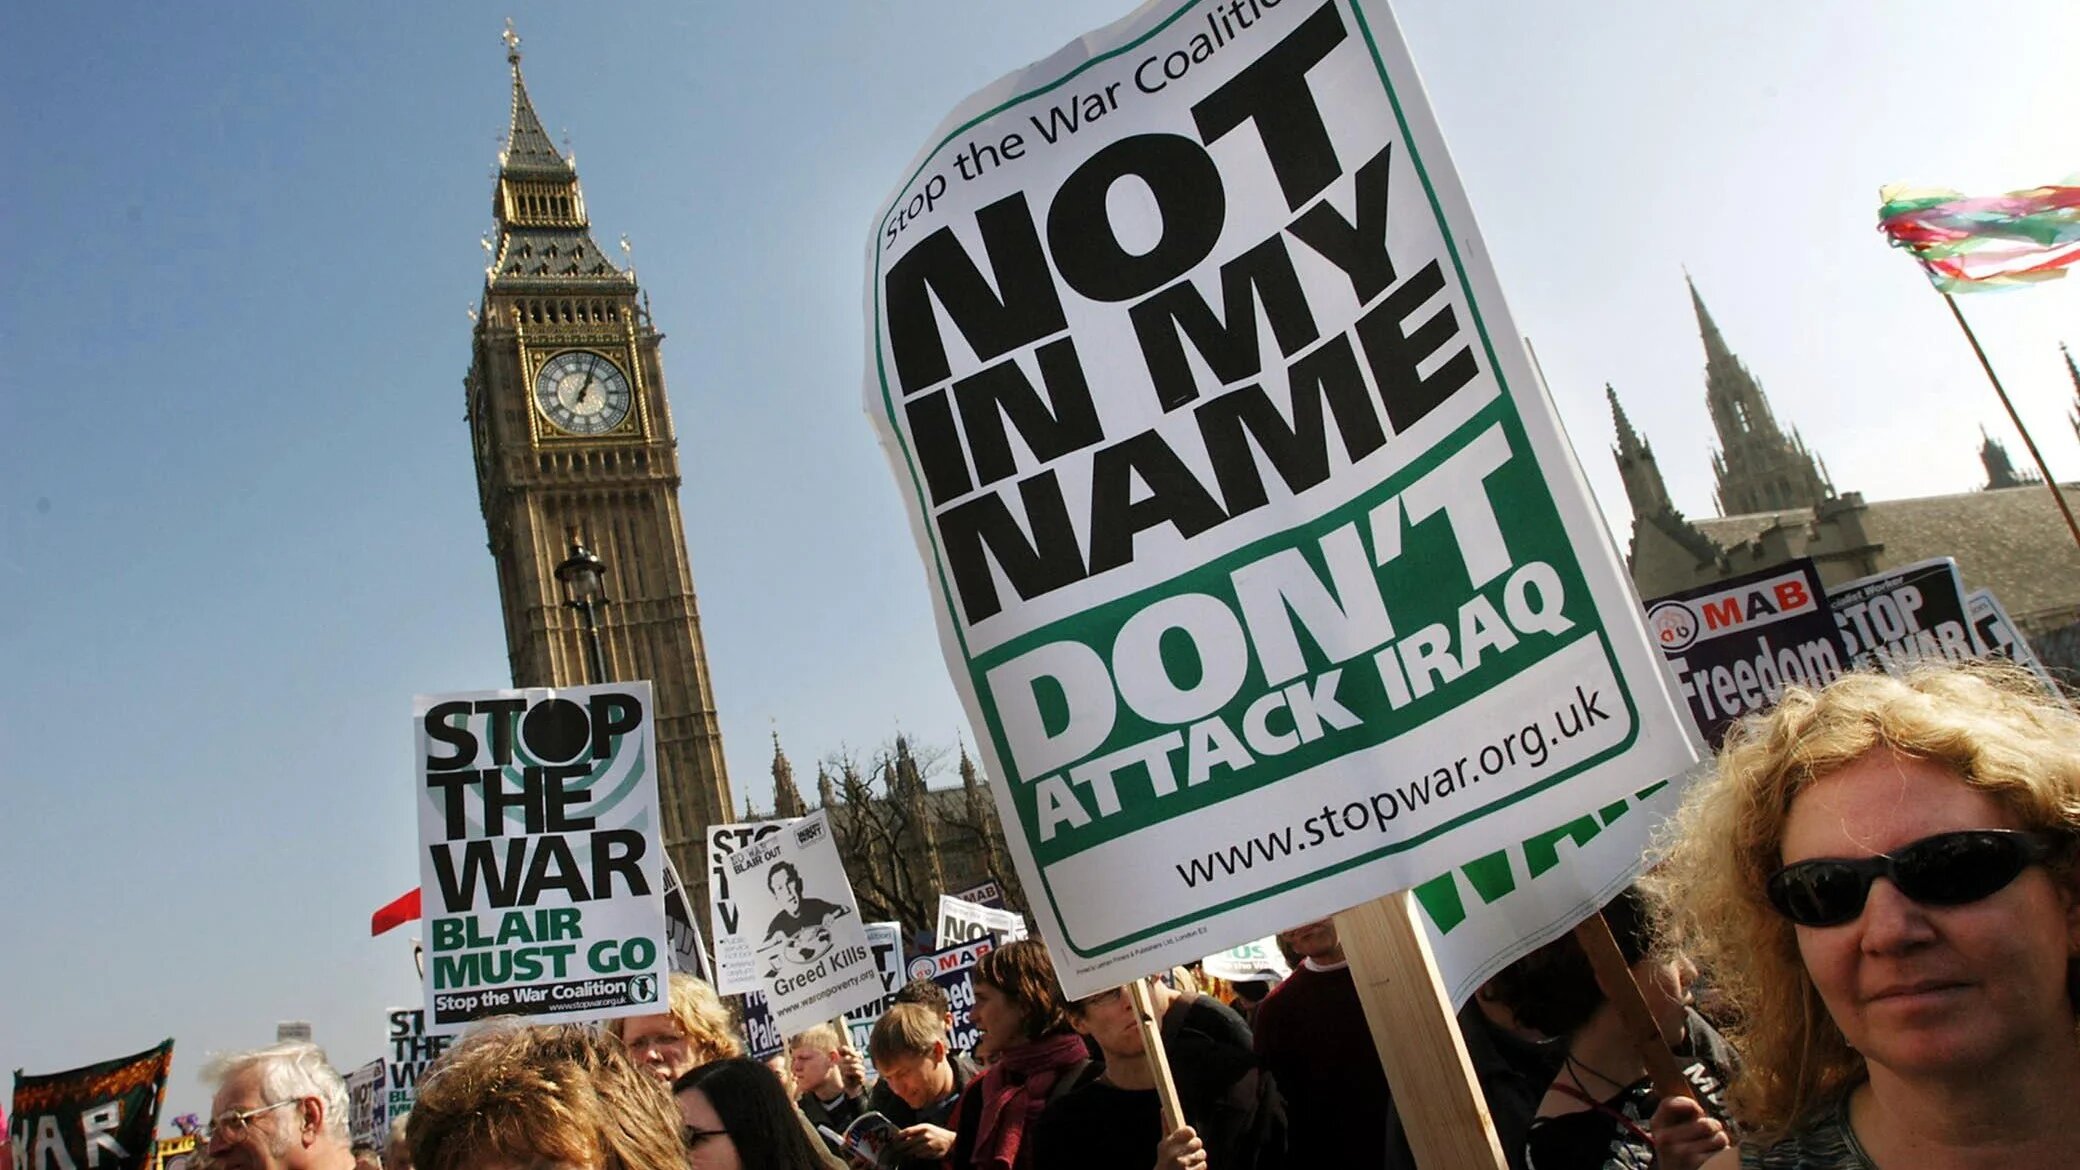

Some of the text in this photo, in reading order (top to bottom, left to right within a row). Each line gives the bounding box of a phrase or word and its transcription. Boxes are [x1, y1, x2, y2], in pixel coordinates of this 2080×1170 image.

[885, 2, 1348, 396] NOT
[886, 175, 947, 250] Stop
[952, 132, 1027, 182] the
[1030, 82, 1122, 145] War
[904, 141, 1398, 508] IN MY
[936, 258, 1480, 627] NAME
[986, 421, 1514, 784] DON'T
[1702, 580, 1809, 631] MAB
[1833, 585, 1924, 657] STOP
[1038, 561, 1577, 843] ATTACK IRAQ
[1668, 635, 1843, 721] Freedom
[424, 692, 643, 771] STOP
[426, 762, 596, 841] THE
[1175, 685, 1611, 888] www.stopwar.org.uk
[429, 828, 652, 914] WAR
[733, 845, 782, 875] BLAIR OUT
[432, 907, 584, 952] BLAIR
[433, 937, 657, 990] MUST GO
[943, 914, 1009, 945] NOT
[436, 980, 627, 1013] Stop the War Coalition
[774, 960, 827, 996] Greed
[828, 946, 867, 972] Kills
[777, 968, 875, 1017] www.waronpoverty.org
